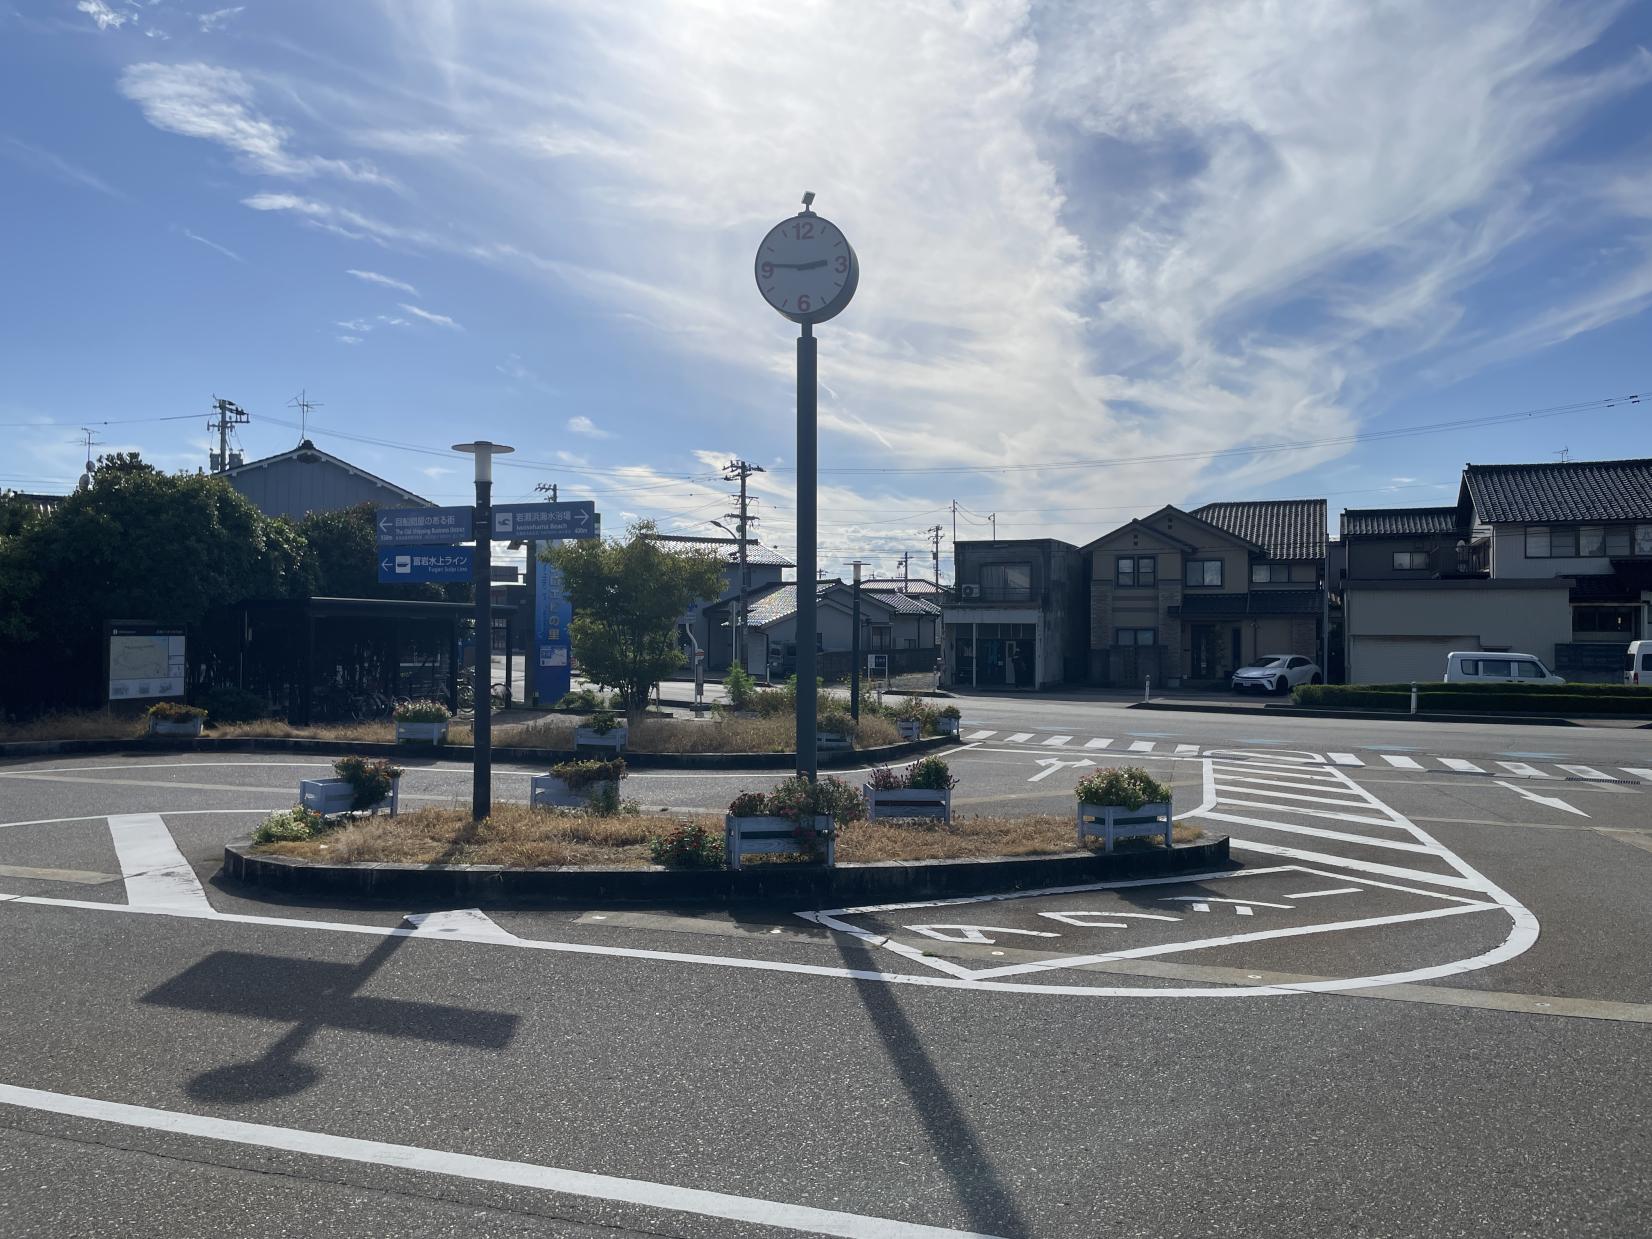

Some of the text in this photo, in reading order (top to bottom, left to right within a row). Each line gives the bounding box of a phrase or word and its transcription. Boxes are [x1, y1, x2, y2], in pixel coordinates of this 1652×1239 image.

[792, 222, 815, 240] 12
[762, 261, 774, 279] 9
[834, 256, 847, 273] 3
[797, 295, 810, 312] 6
[902, 887, 1365, 944] タクシー
